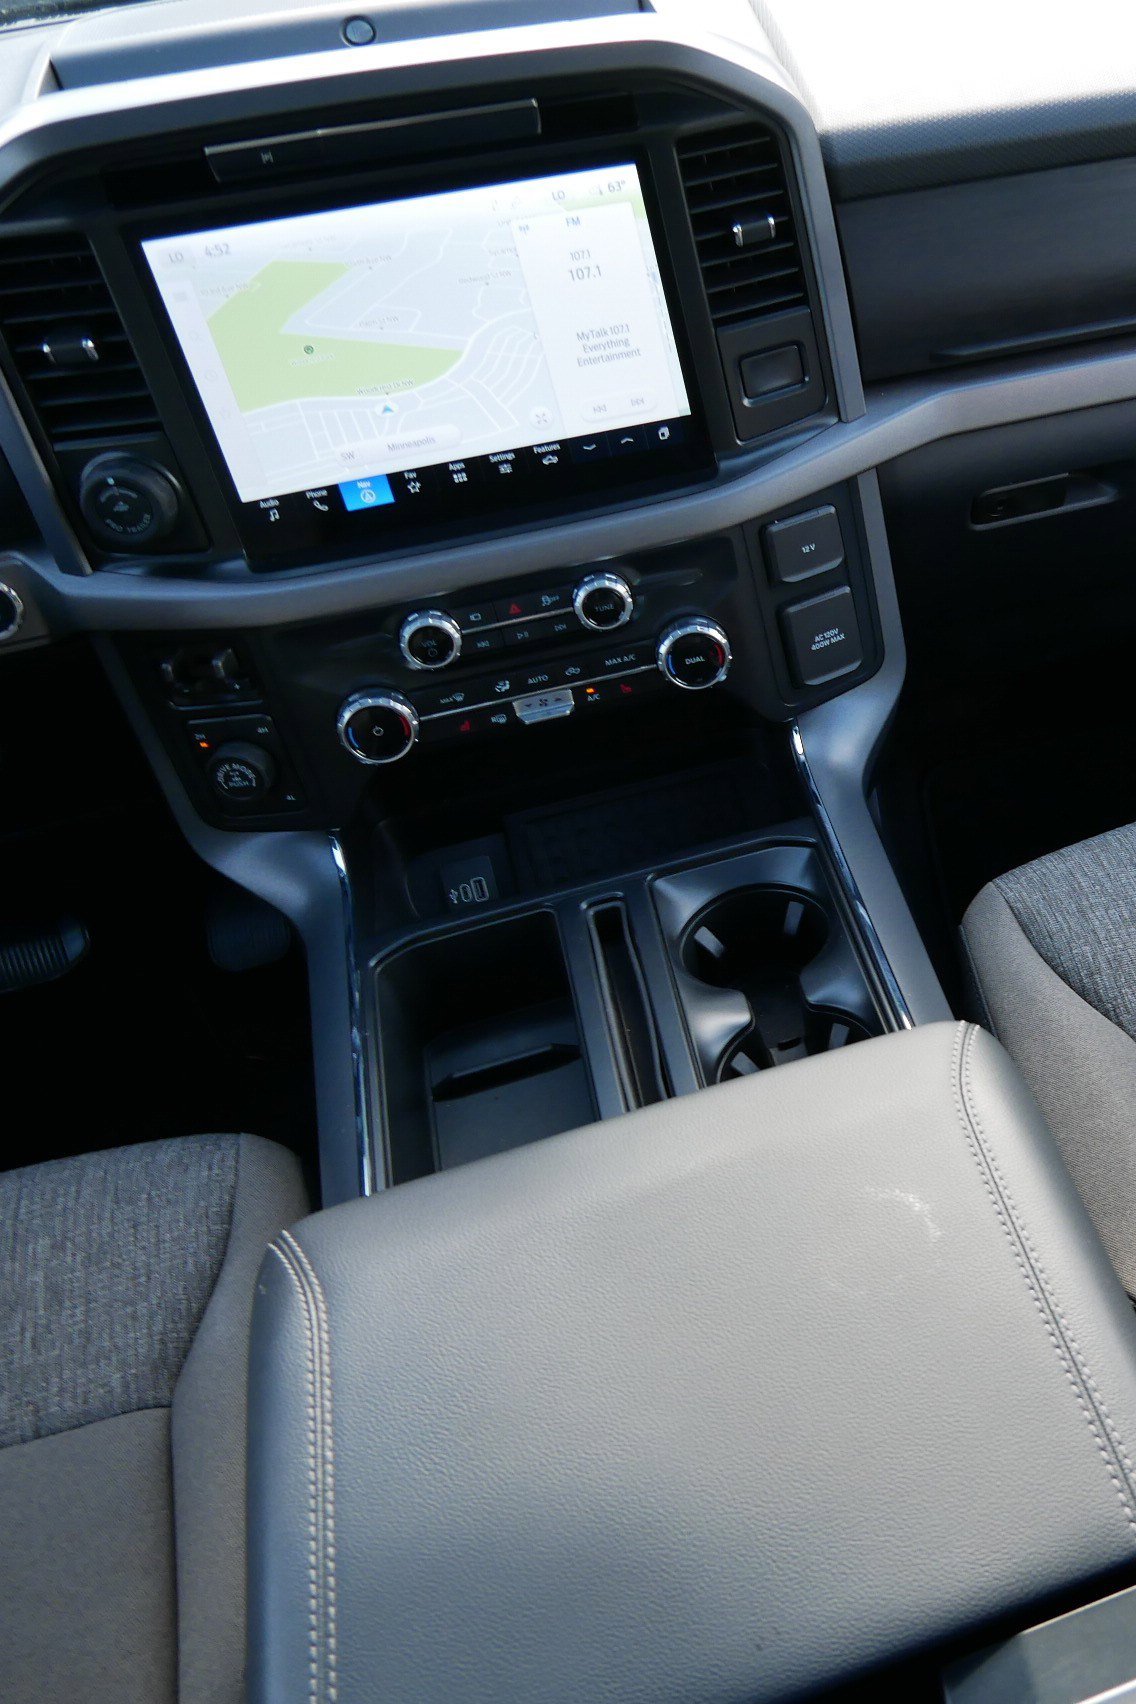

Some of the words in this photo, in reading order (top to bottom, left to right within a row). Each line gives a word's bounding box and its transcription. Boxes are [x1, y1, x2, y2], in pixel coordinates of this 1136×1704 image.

[566, 216, 581, 228] FM
[204, 243, 232, 259] 4:52
[568, 265, 602, 282] 107.1
[577, 327, 609, 343] MyTalk
[610, 323, 631, 336] 107.1
[582, 337, 631, 354] Everything
[577, 348, 642, 368] Entertainment
[387, 435, 437, 454] Minneapolis
[533, 442, 561, 455] Features
[340, 450, 356, 462] SW
[489, 451, 516, 465] Settings
[448, 462, 466, 472] Apps
[404, 472, 417, 480] Fav
[357, 480, 371, 489] Nav
[306, 488, 328, 499] Phone
[259, 498, 279, 509] Audio
[801, 545, 810, 554] 12
[810, 543, 817, 551] V
[594, 603, 615, 613] TUNE
[814, 634, 824, 643] AC
[824, 627, 839, 639] 120V
[421, 640, 438, 648] VOL
[811, 639, 830, 651] 400W
[830, 633, 846, 644] MAX
[605, 657, 623, 667] MAX
[623, 653, 637, 663] A/C
[684, 655, 705, 666] DUAL
[527, 674, 549, 685] AUTO
[587, 693, 601, 703] A/C
